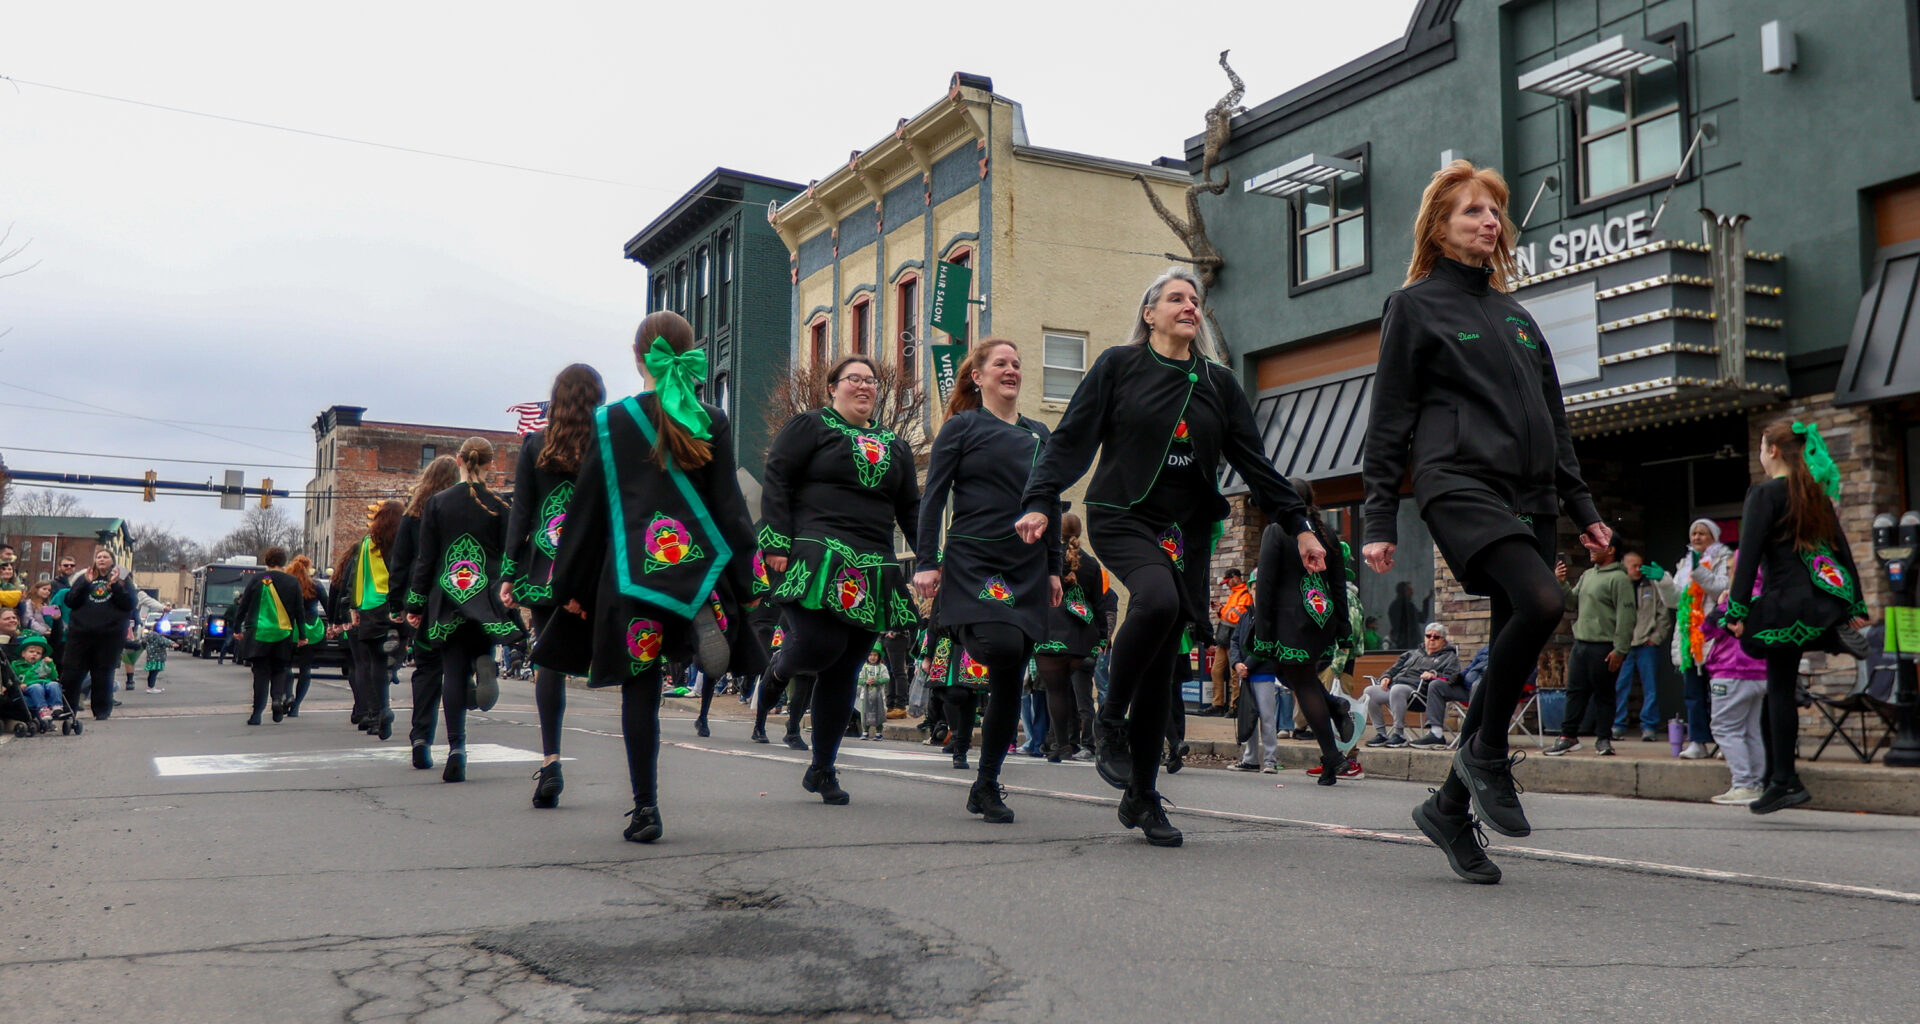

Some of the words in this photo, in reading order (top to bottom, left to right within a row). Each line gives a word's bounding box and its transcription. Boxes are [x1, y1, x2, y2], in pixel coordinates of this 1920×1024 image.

[1548, 209, 1648, 270] SPACE
[938, 265, 948, 288] HAIR
[934, 290, 945, 323] SALON
[941, 353, 955, 395] VIRGI
